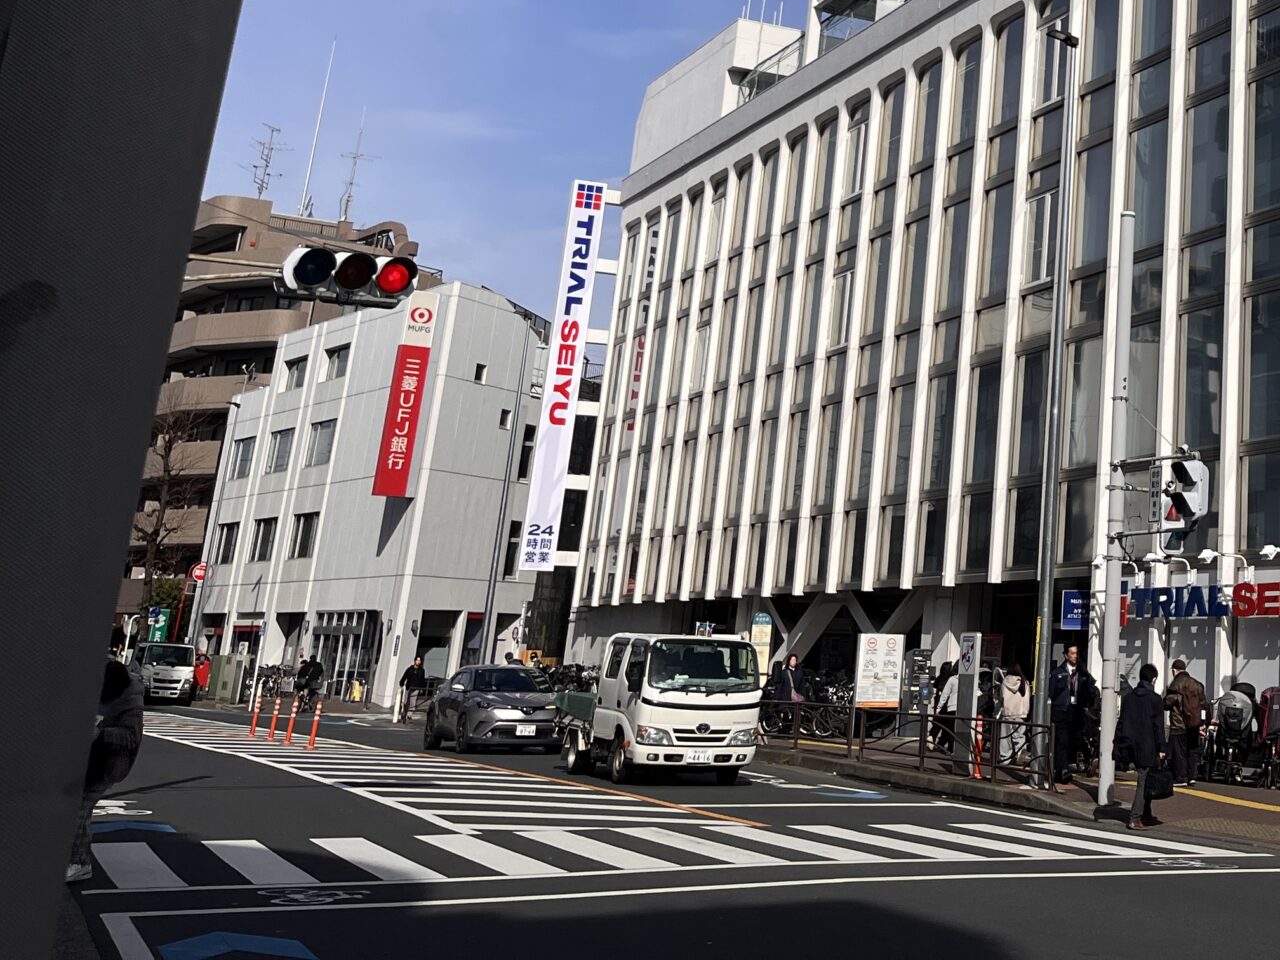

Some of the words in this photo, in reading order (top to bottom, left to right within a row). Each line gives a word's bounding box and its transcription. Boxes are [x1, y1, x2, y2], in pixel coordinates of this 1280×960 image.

[564, 214, 596, 316] TRIAL
[407, 324, 431, 334] MUFG
[548, 320, 579, 426] SEIYU
[387, 358, 421, 470] 三菱UFJ銀行
[527, 523, 555, 537] 24
[1130, 586, 1230, 619] TRIAL
